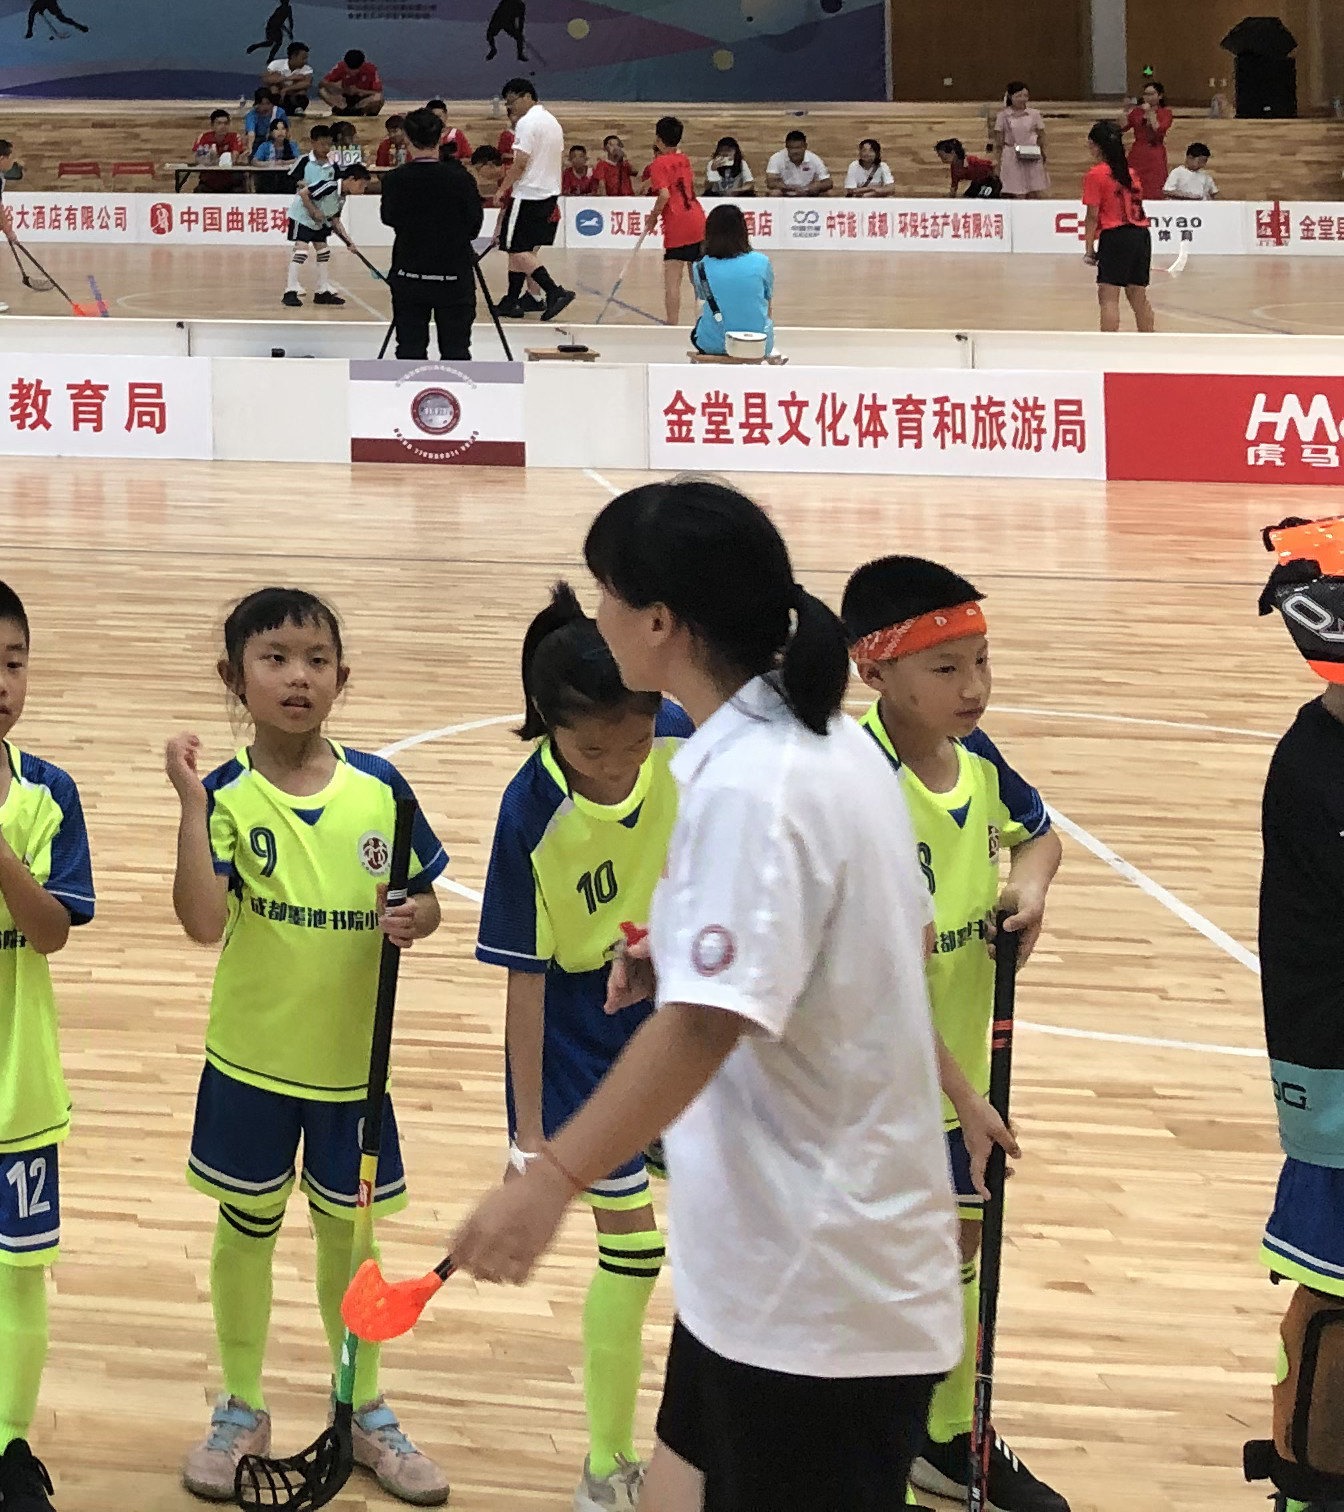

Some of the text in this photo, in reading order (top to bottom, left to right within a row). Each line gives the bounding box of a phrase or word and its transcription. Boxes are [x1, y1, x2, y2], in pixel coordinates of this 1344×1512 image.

[179, 206, 289, 233] 中国曲棍球
[662, 389, 1087, 455] 金堂县文化体育和旅游局
[1245, 393, 1344, 443] HM
[1247, 443, 1341, 467] 虎马
[249, 826, 278, 878] 9
[576, 859, 619, 915] 10
[7, 1156, 52, 1220] 12
